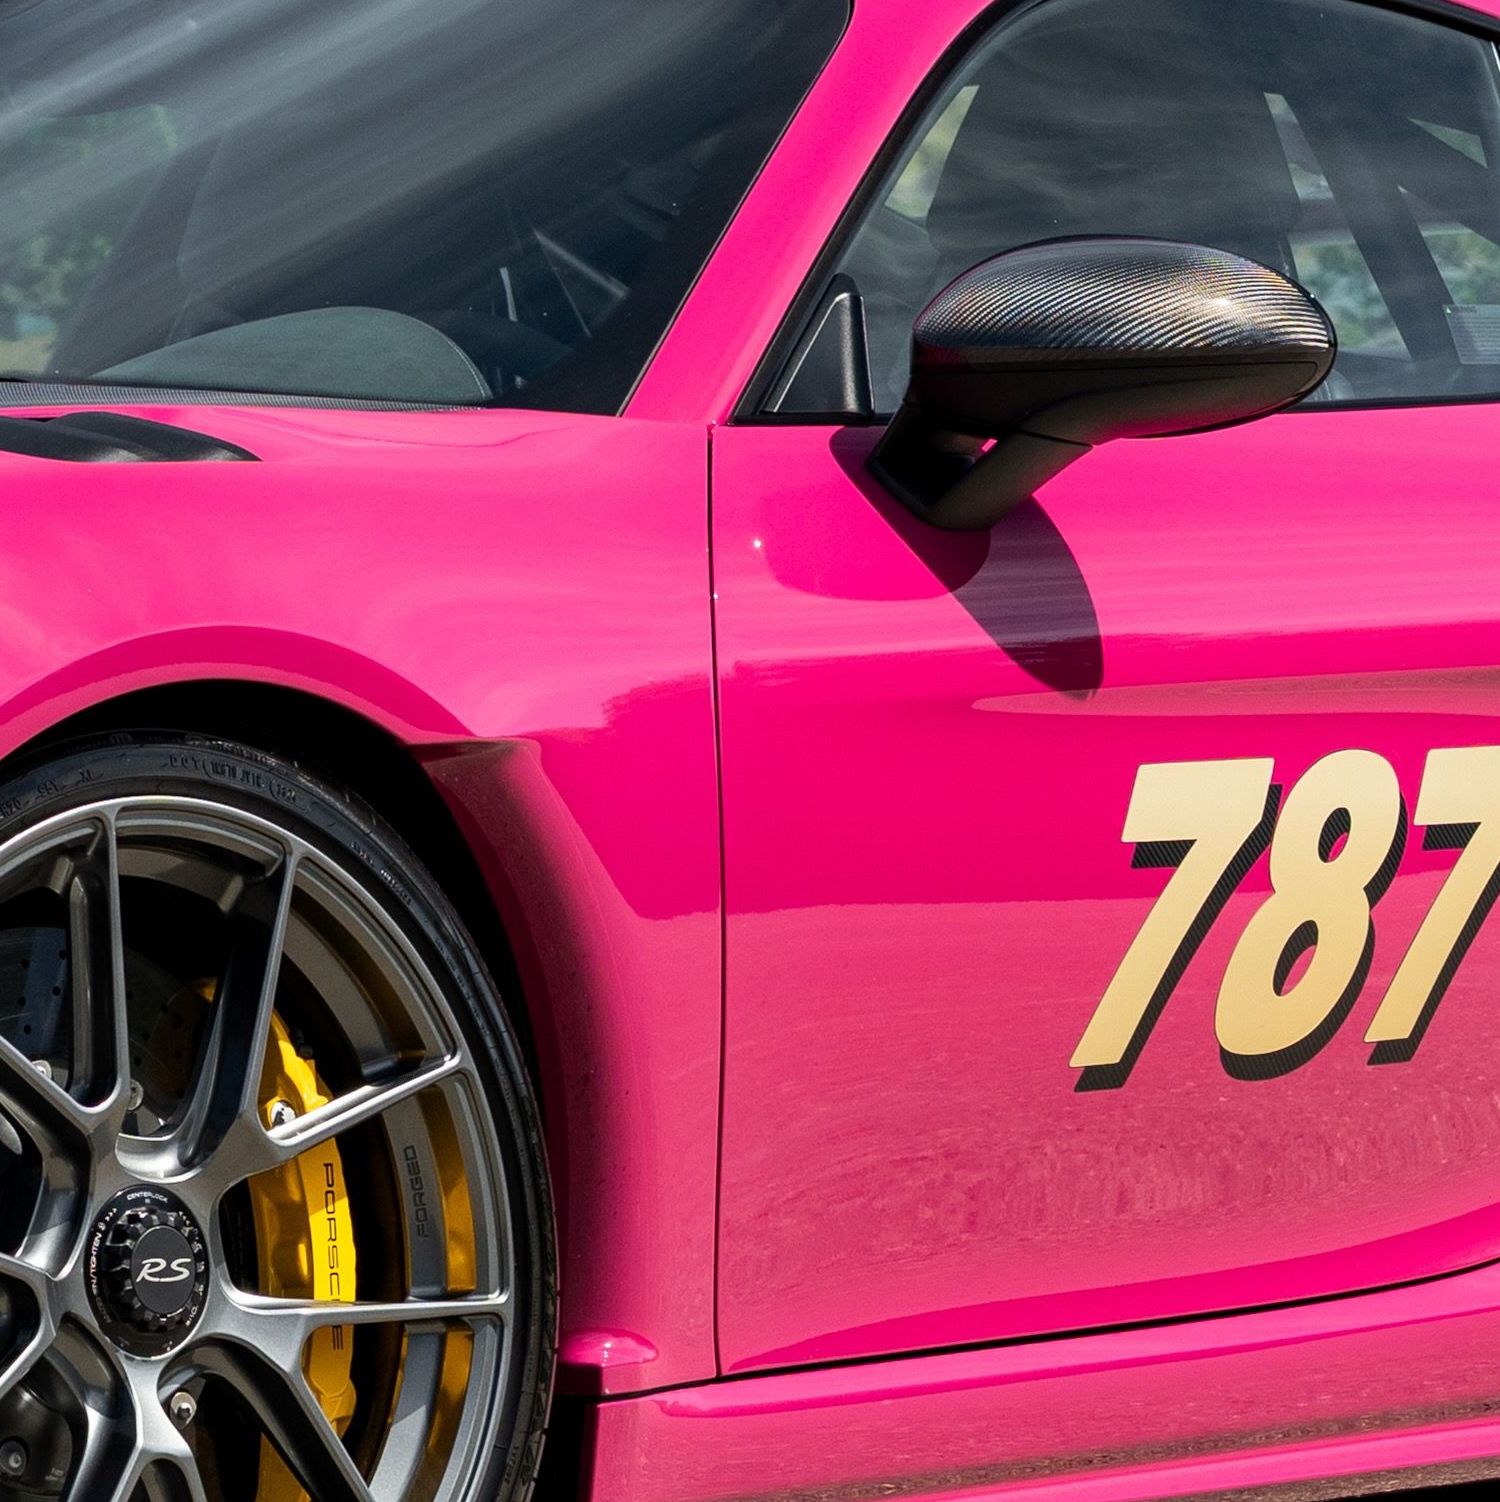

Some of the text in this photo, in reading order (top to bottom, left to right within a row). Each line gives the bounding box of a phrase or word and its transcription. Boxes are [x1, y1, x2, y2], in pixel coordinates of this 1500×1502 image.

[404, 1145, 429, 1238] FORGED
[136, 1257, 192, 1282] RS
[322, 1163, 344, 1351] PORSCE
